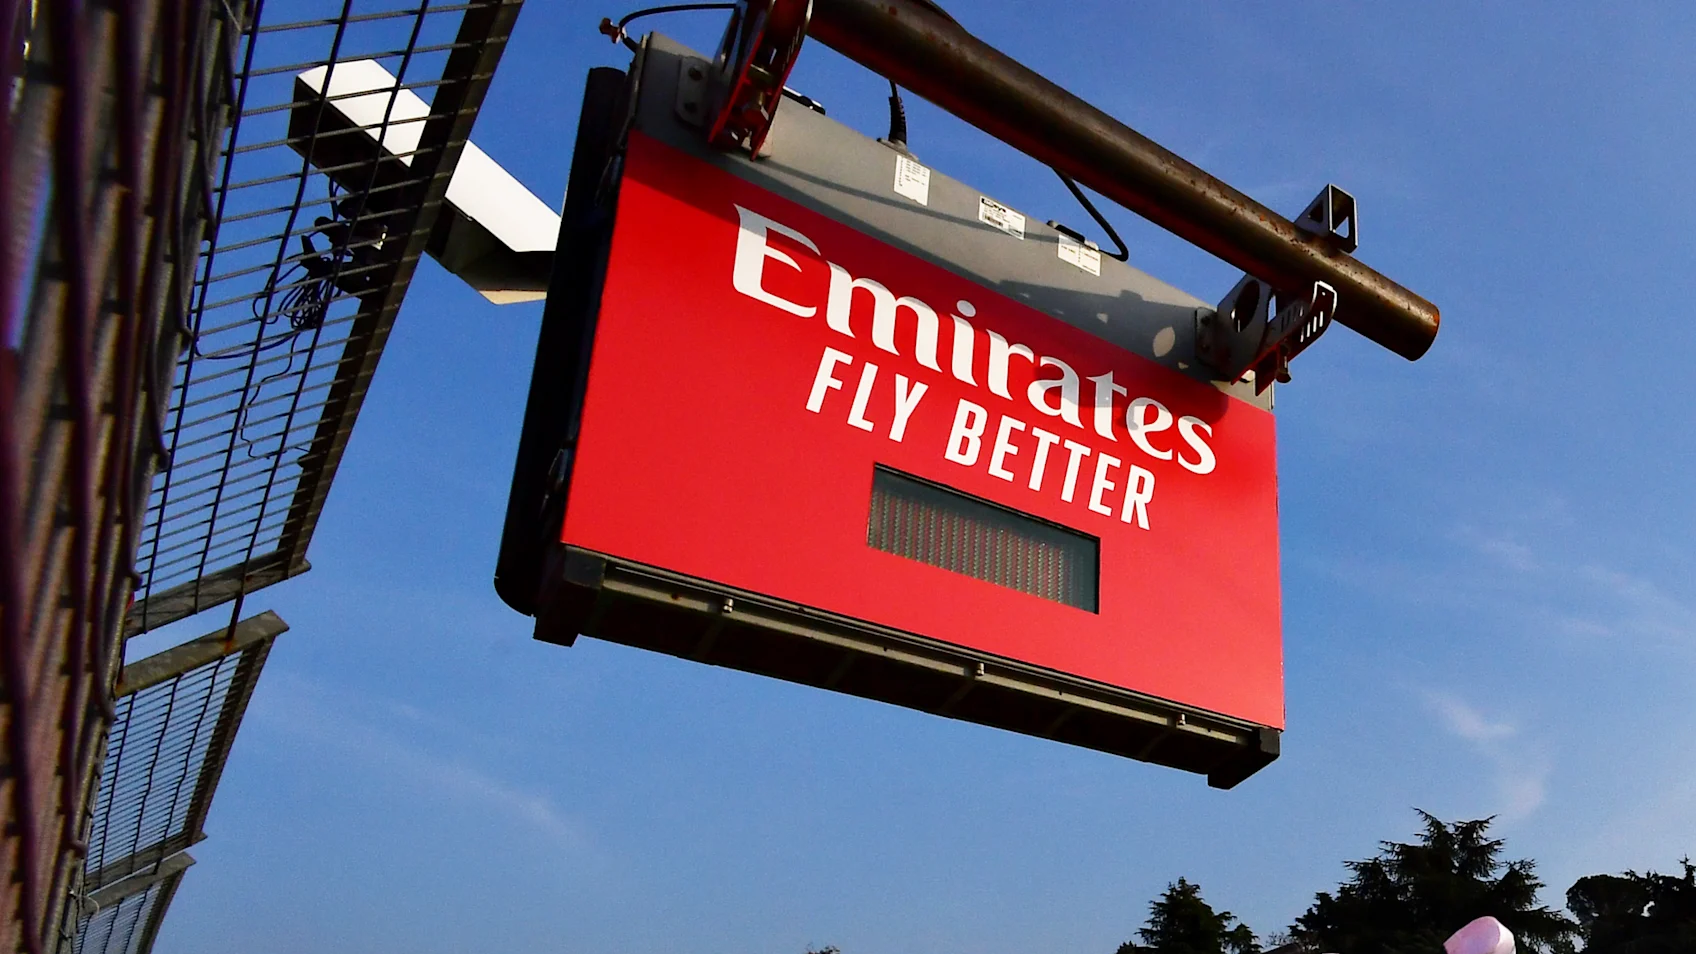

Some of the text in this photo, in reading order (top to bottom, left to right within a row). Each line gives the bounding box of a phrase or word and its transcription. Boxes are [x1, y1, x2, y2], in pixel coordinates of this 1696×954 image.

[732, 204, 1217, 475] Emirates
[806, 347, 1157, 531] FLY BETTER
